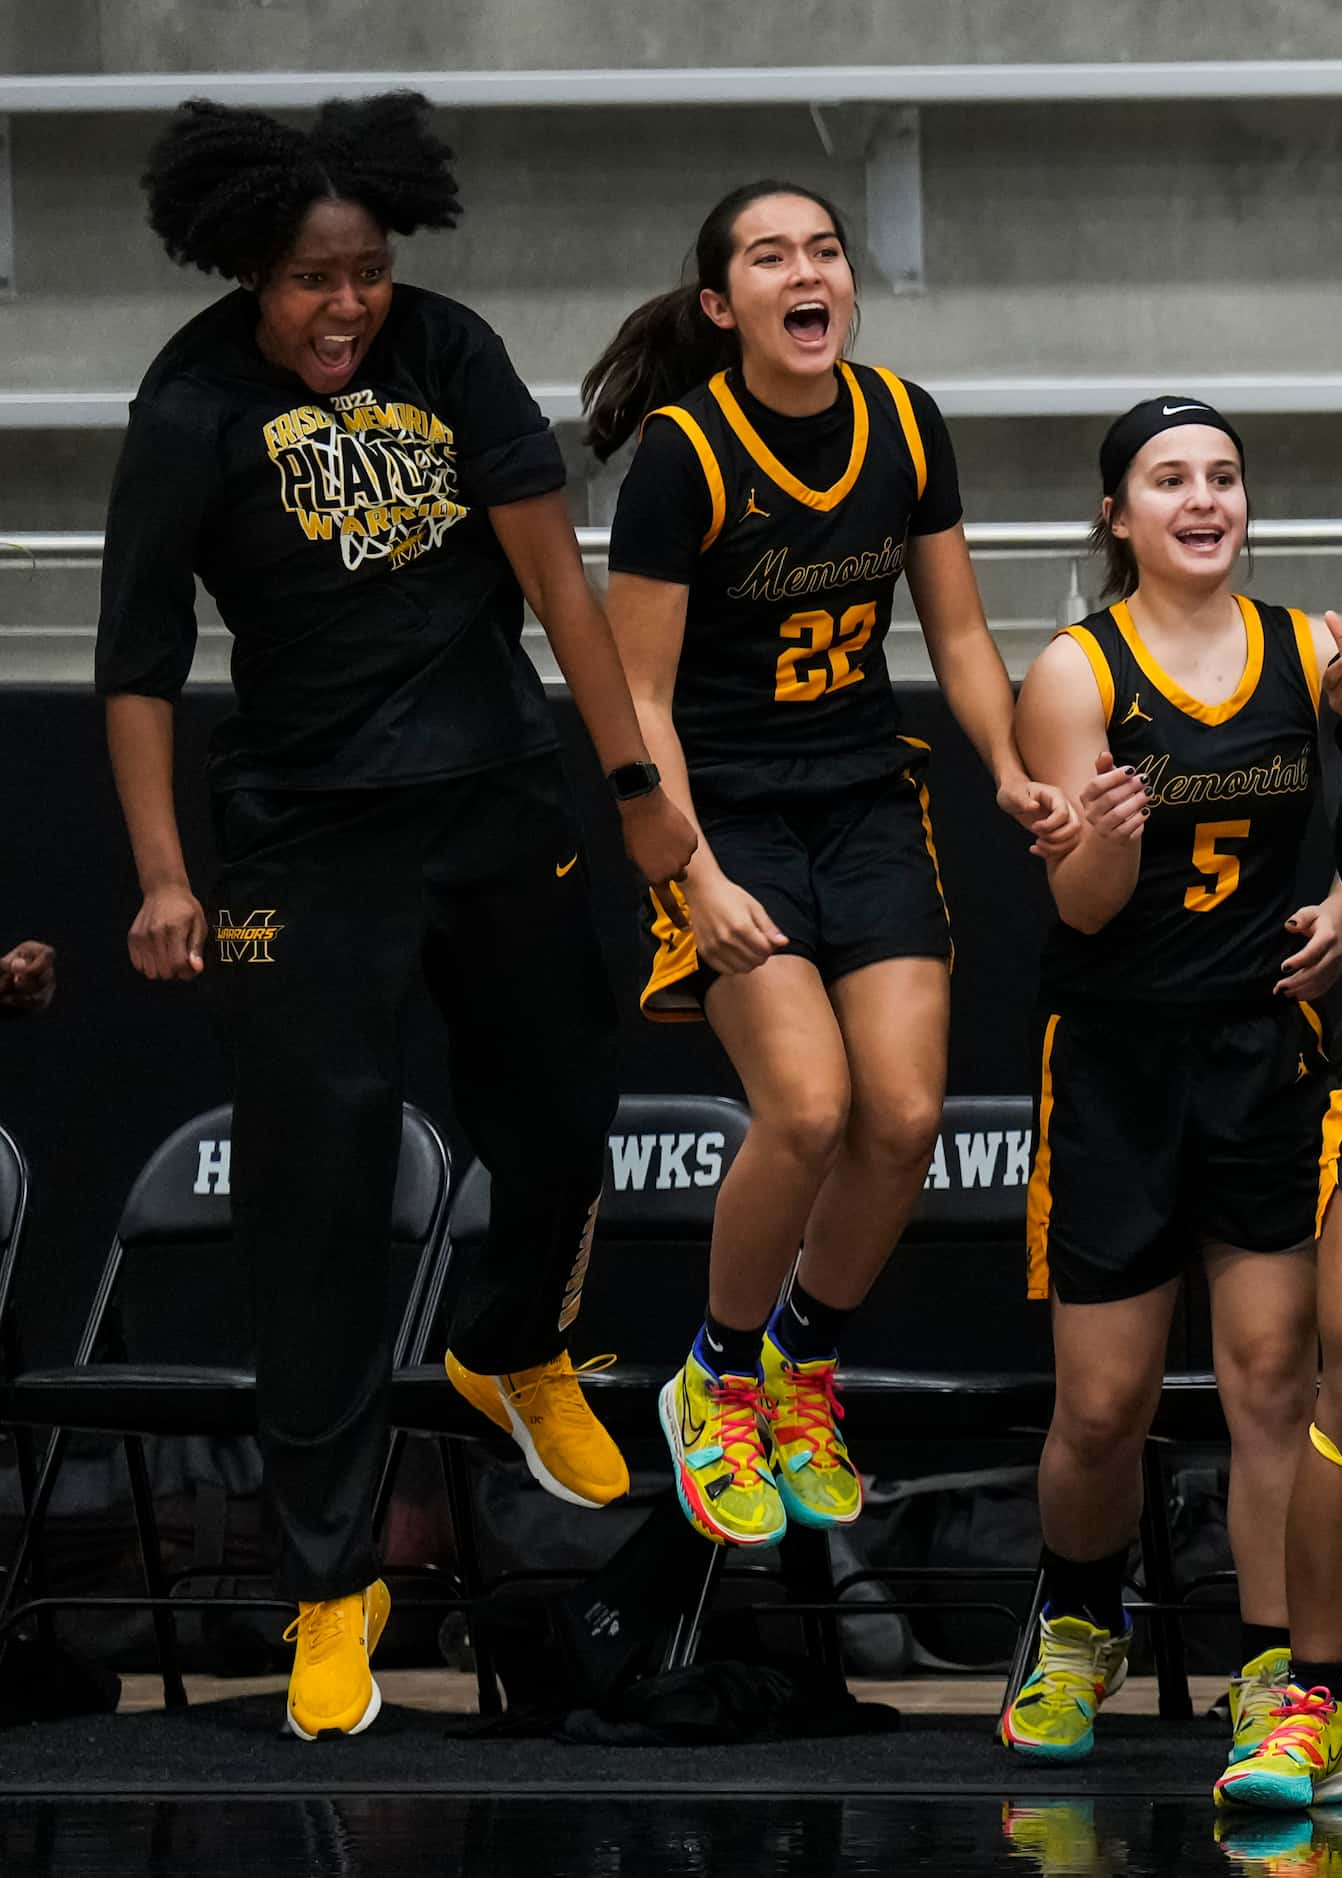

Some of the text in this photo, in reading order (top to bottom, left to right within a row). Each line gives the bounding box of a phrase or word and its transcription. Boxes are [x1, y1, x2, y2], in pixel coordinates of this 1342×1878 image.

[330, 389, 377, 411] 2022
[774, 600, 877, 702] 22
[1184, 819, 1250, 912] 5
[216, 927, 278, 940] WARRIORS
[608, 1132, 725, 1191] WKS
[922, 1130, 1033, 1190] AWK
